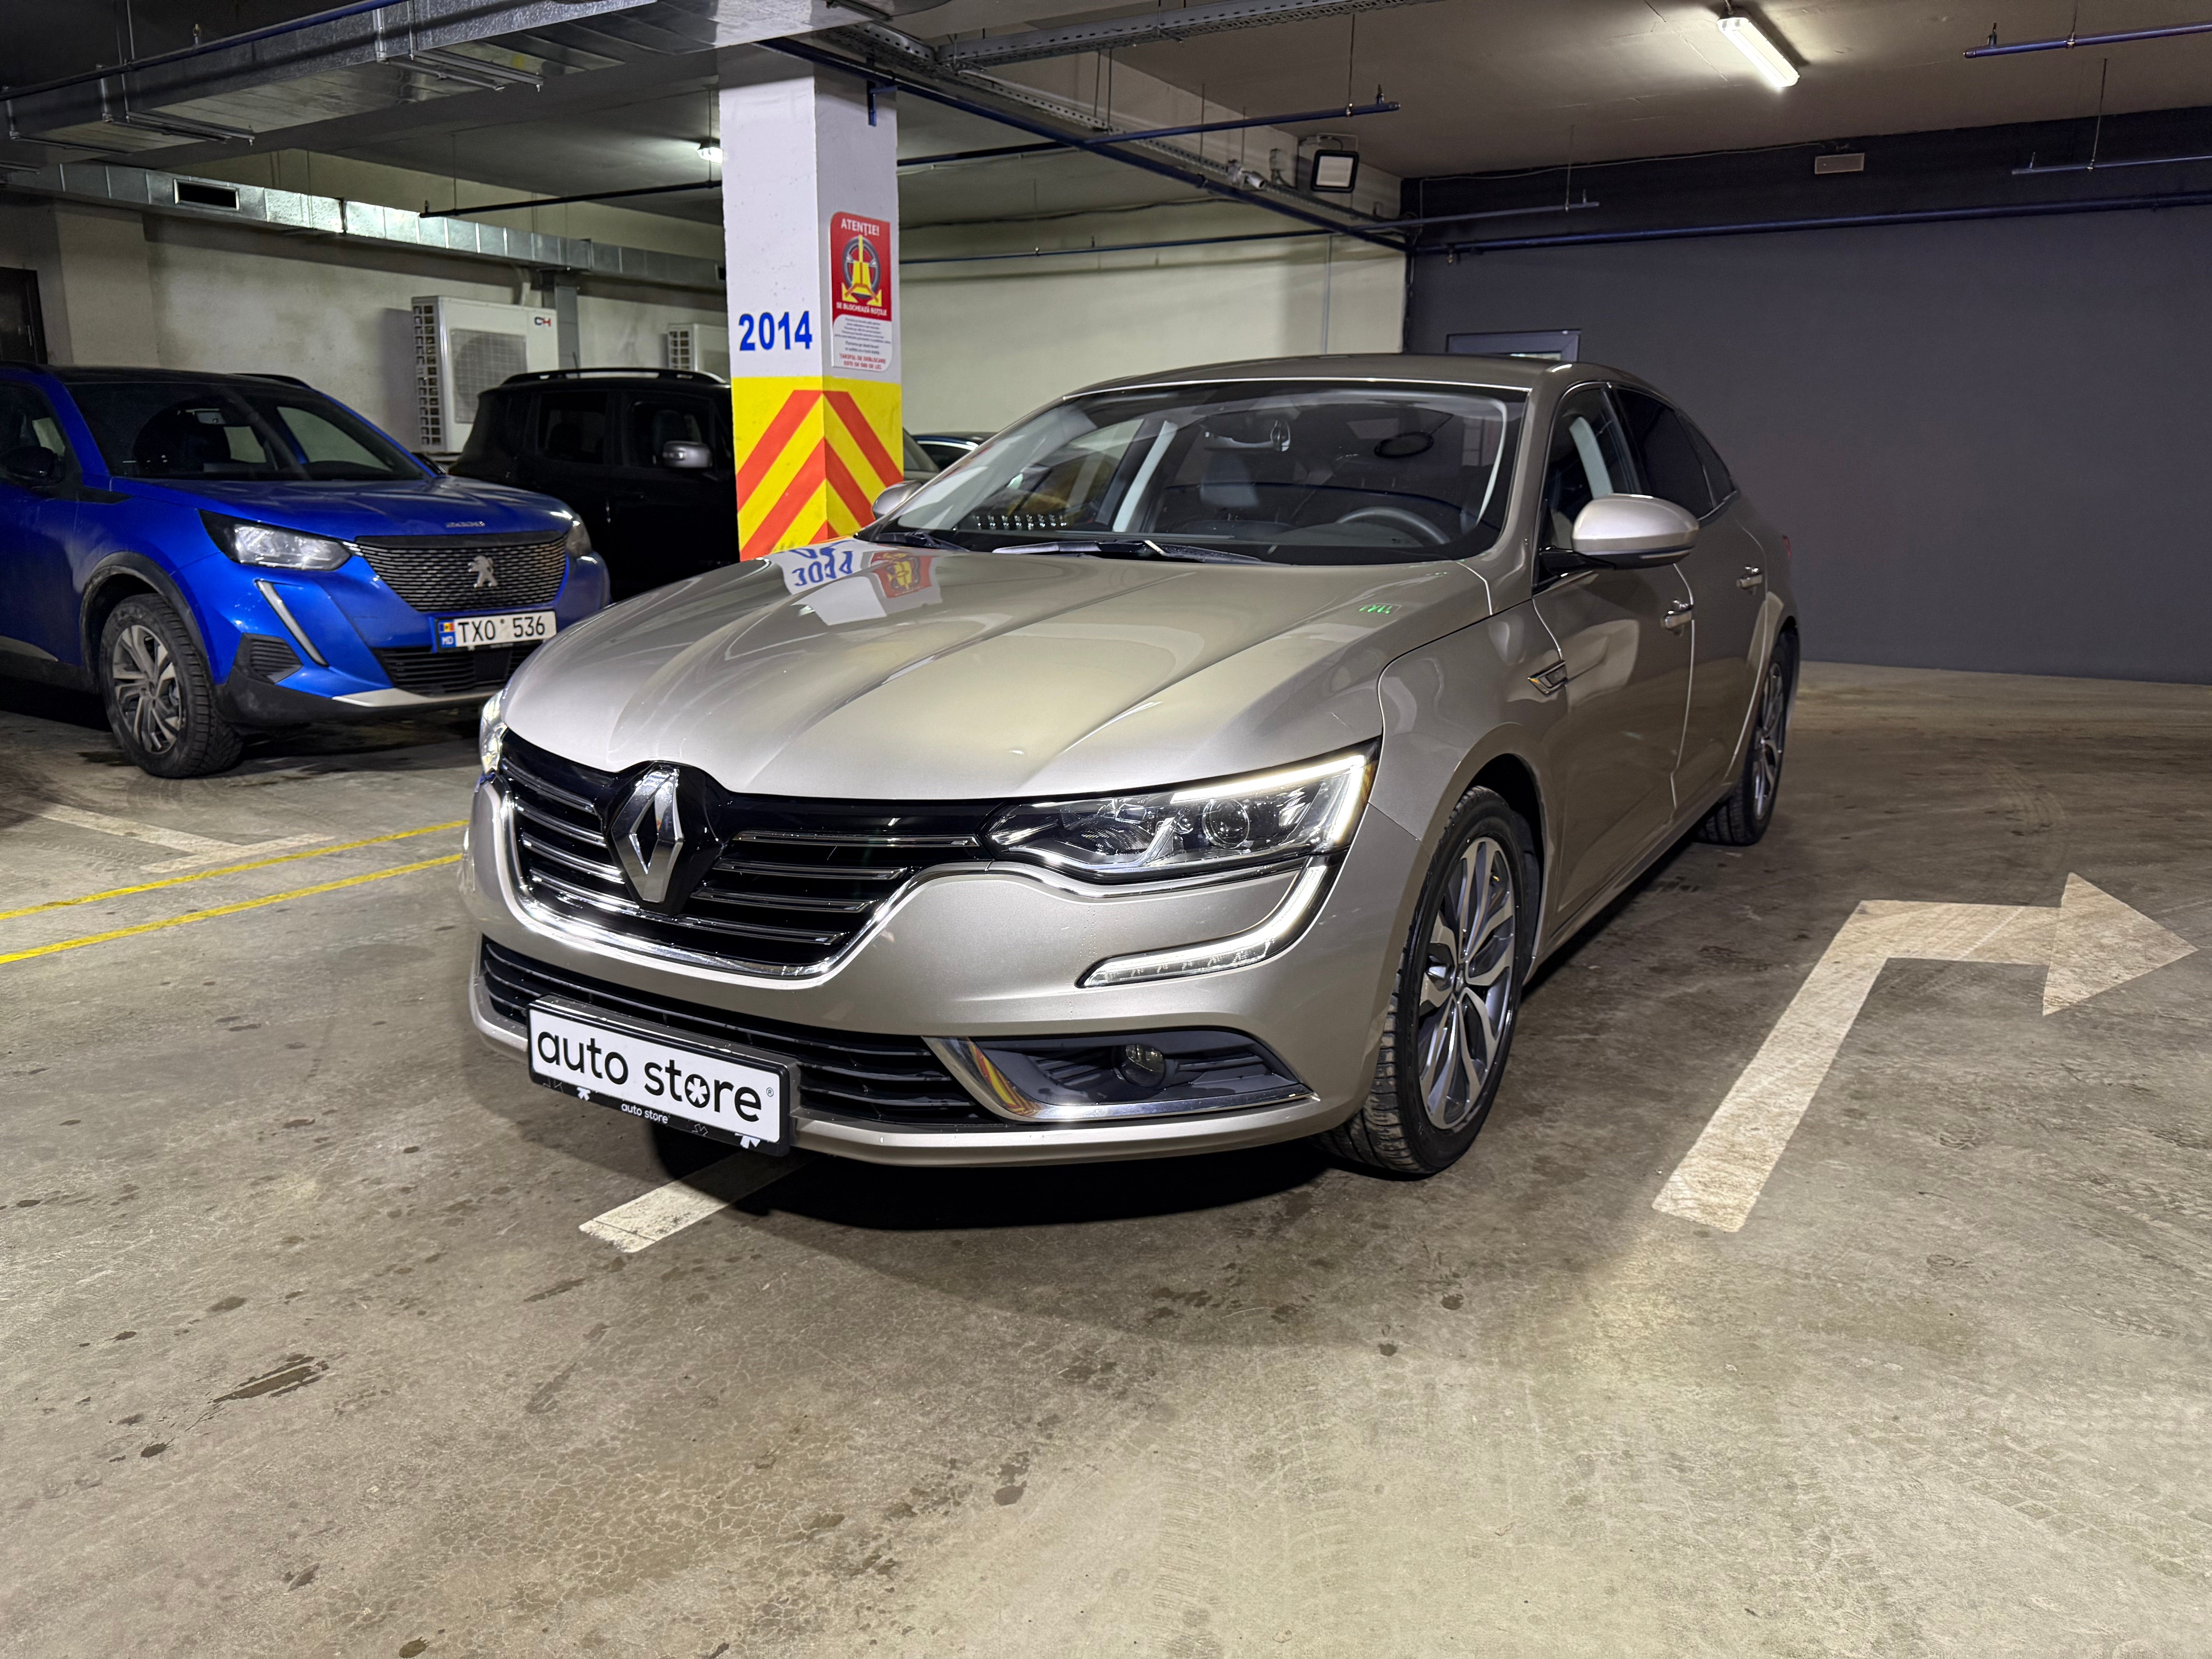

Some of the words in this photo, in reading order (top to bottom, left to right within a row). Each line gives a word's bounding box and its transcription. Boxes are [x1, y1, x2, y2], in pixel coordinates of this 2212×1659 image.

[739, 311, 812, 351] 2014
[442, 635, 454, 645] MD
[458, 620, 495, 643] TXO
[513, 616, 545, 638] 536
[538, 1031, 629, 1085] auto
[621, 1103, 642, 1116] auto
